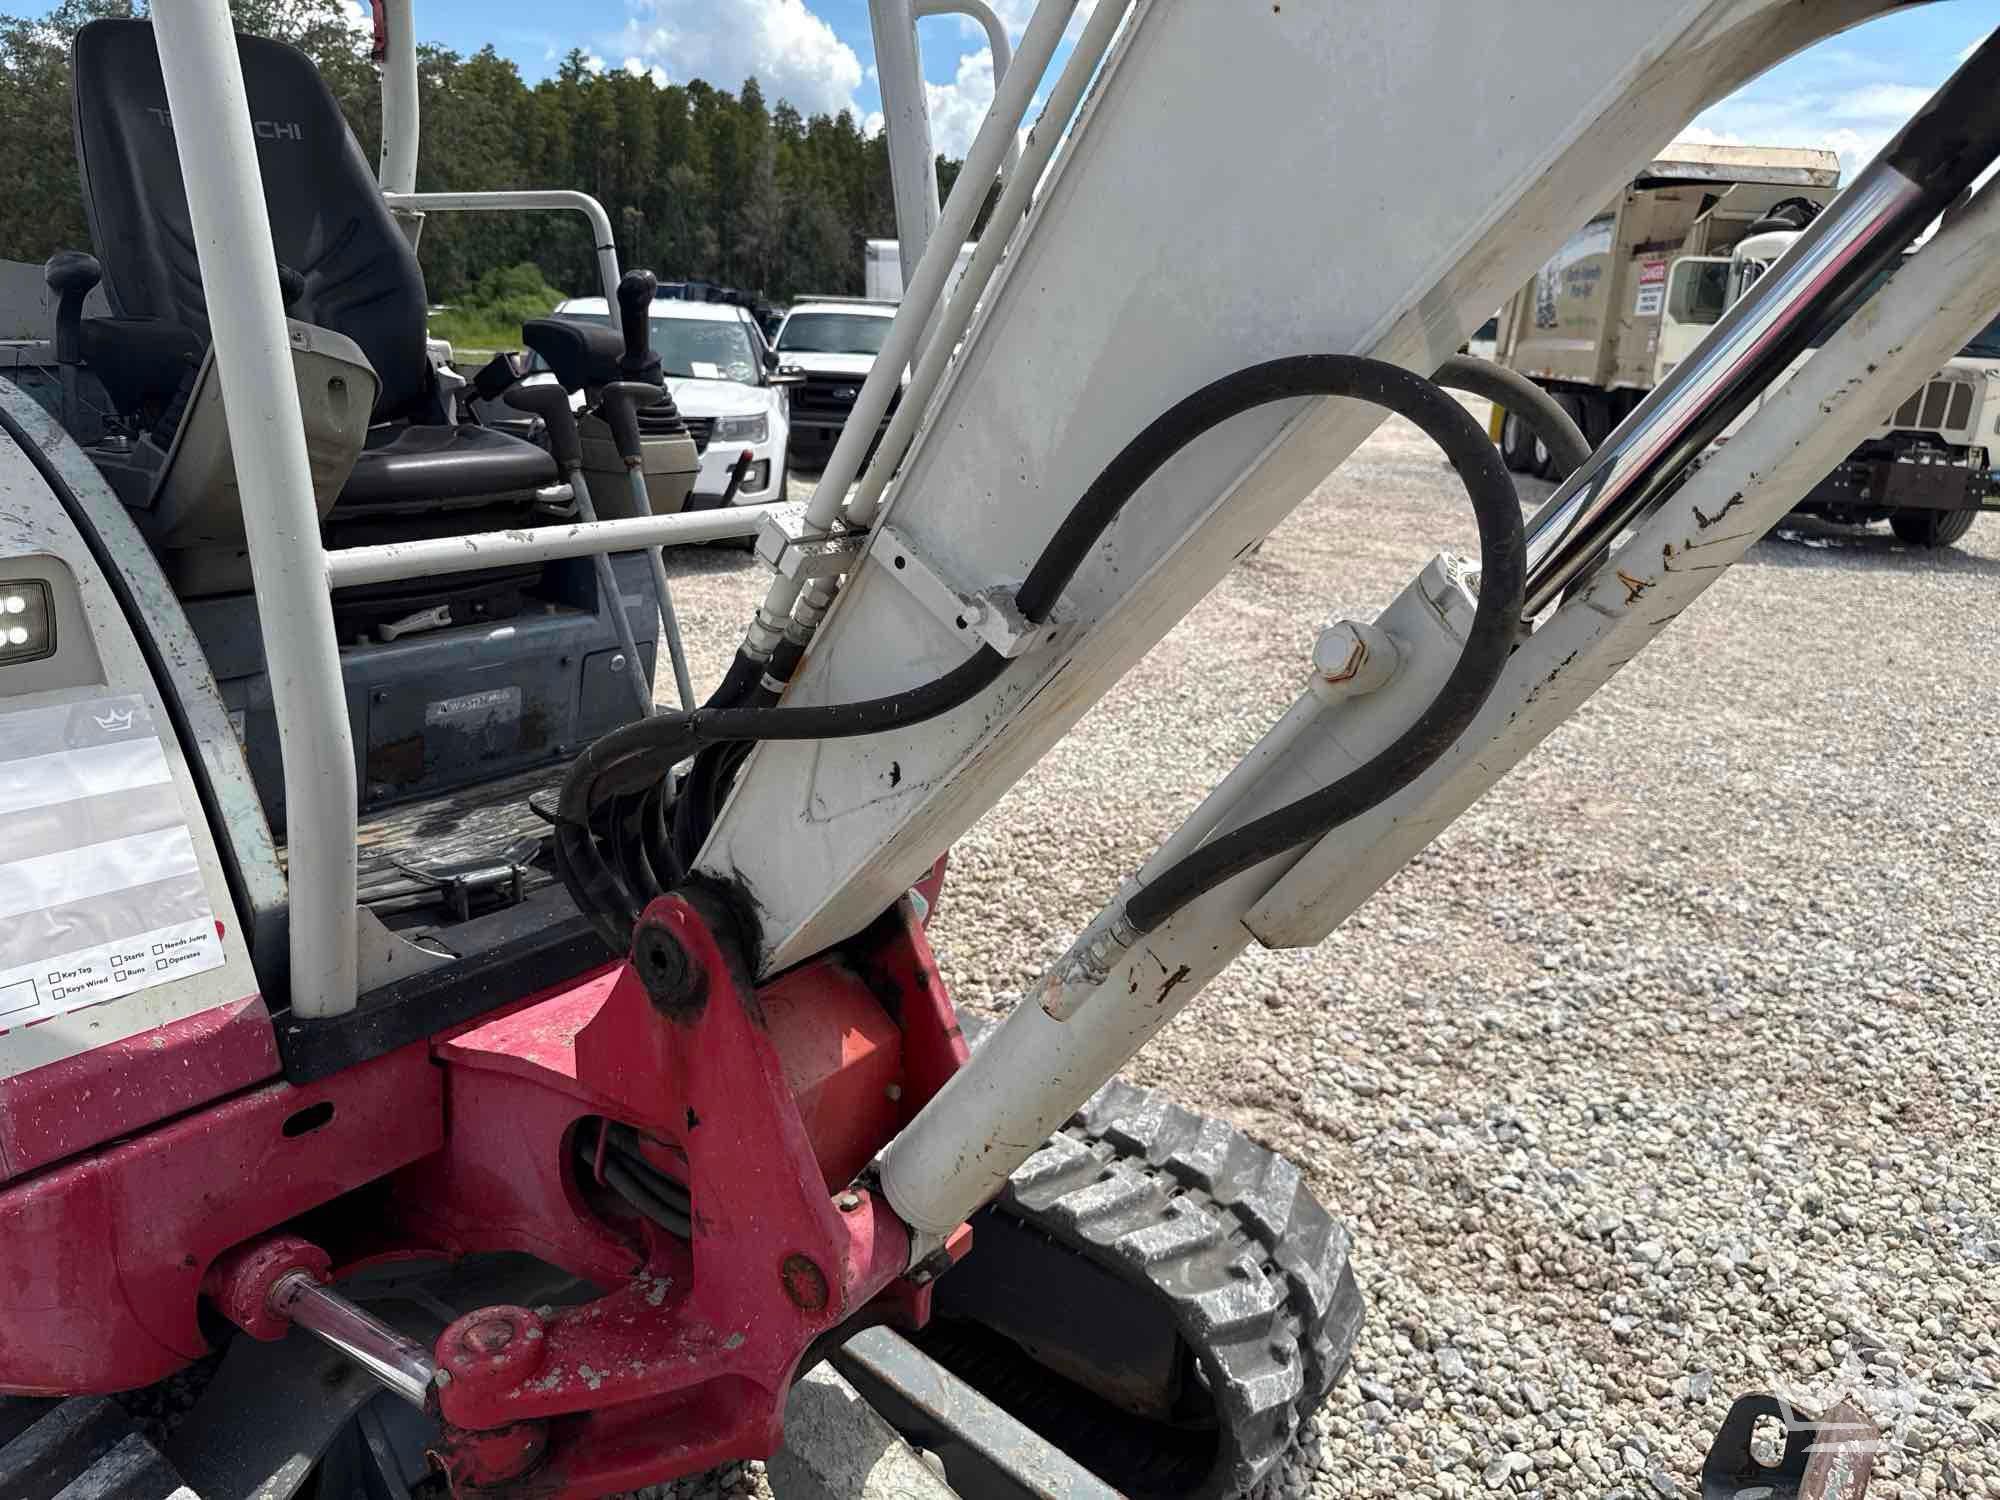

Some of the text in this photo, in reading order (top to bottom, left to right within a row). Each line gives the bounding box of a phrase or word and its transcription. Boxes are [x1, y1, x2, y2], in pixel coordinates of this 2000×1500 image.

[164, 933, 208, 949] Needs Jump
[123, 951, 145, 962] Starts
[168, 951, 201, 964] Operates
[61, 966, 92, 980] Key Tag
[127, 967, 145, 976] Runs
[66, 976, 109, 994] Keys Wired
